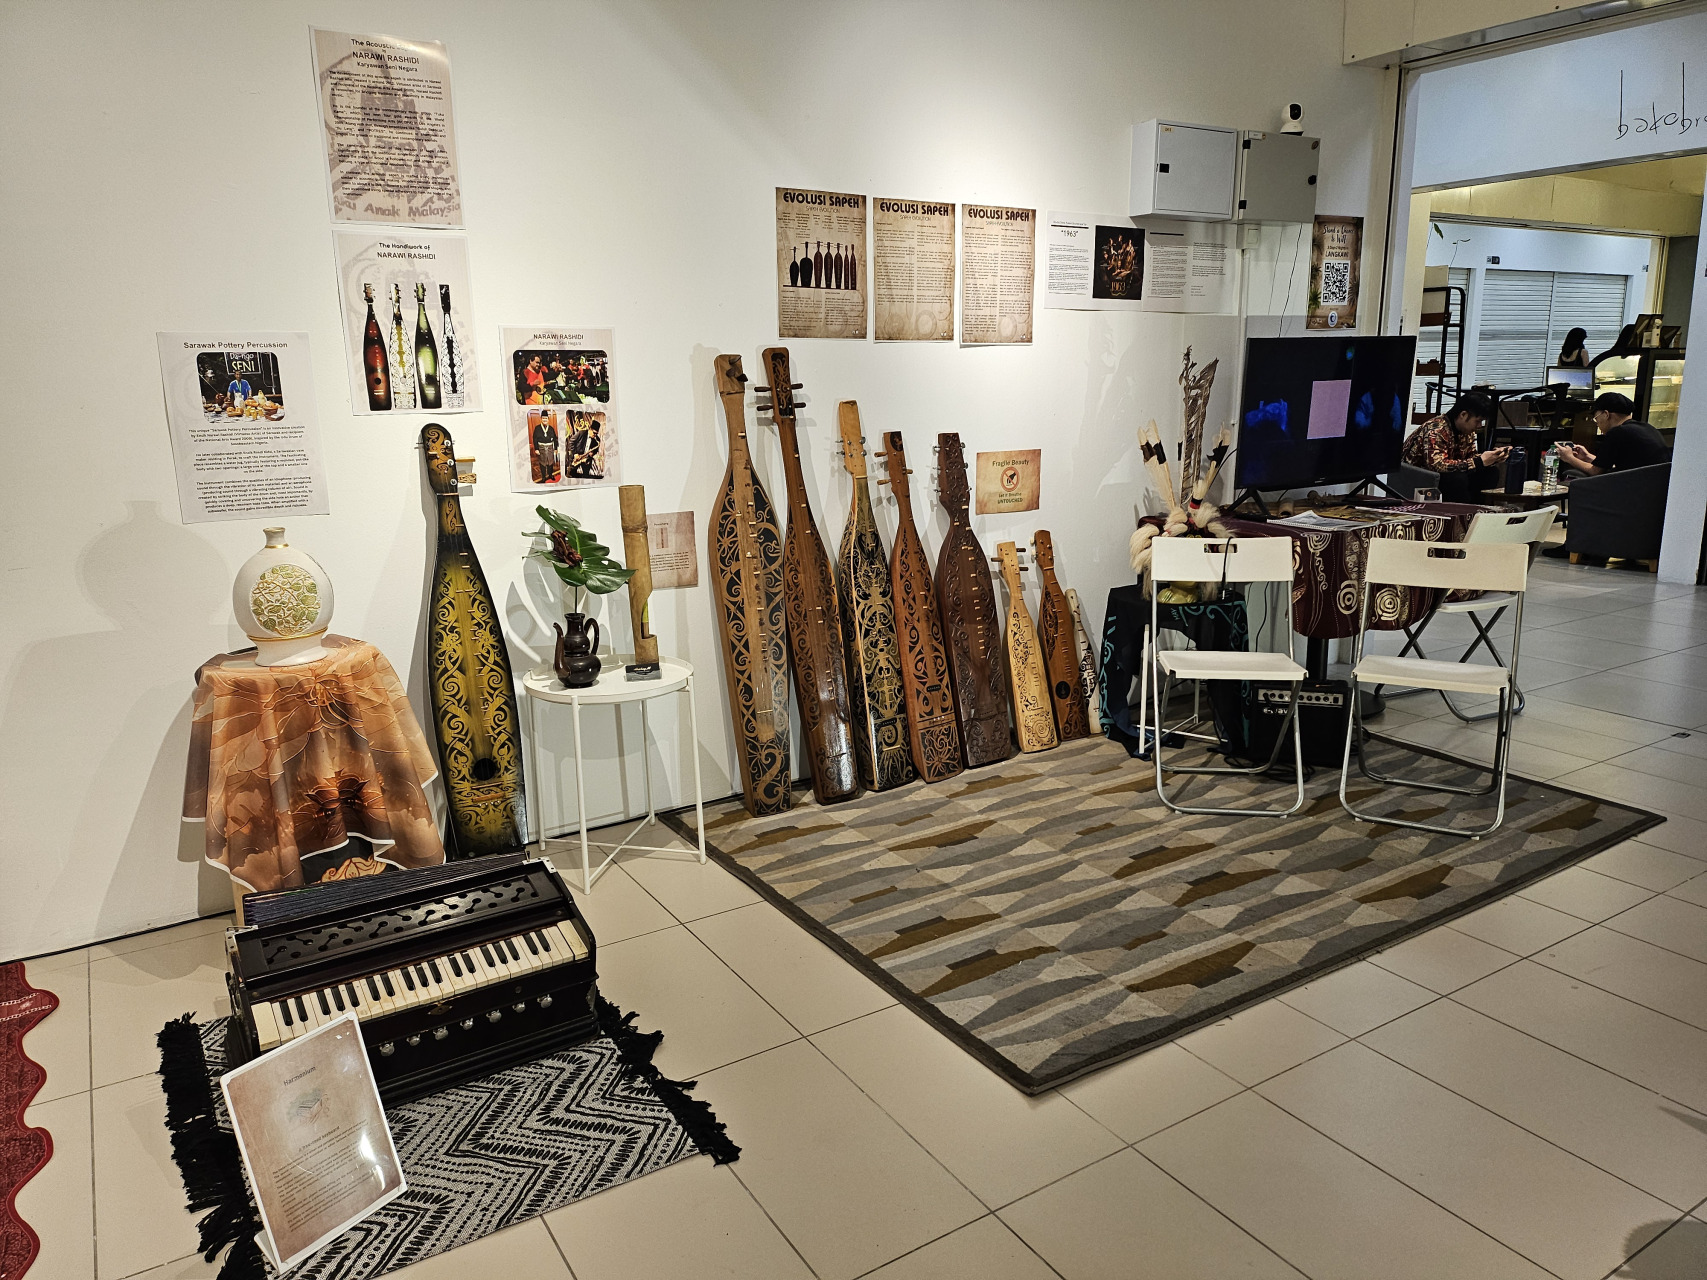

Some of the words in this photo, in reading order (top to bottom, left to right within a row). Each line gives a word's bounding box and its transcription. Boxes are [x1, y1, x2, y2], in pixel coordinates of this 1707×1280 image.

[352, 51, 386, 62] NARAWI
[387, 54, 420, 64] RASHIDI
[357, 61, 384, 69] Karyawan
[398, 65, 418, 73] Negara
[783, 192, 826, 206] EVOLUSI
[829, 196, 859, 208] SAPEH
[880, 202, 918, 214] EVOLUSI
[922, 205, 949, 216] SAPEH
[968, 208, 1002, 220] EVOLUSI
[1006, 210, 1030, 222] SAPEH
[232, 361, 254, 372] SENI
[284, 1066, 316, 1086] Harmonium
